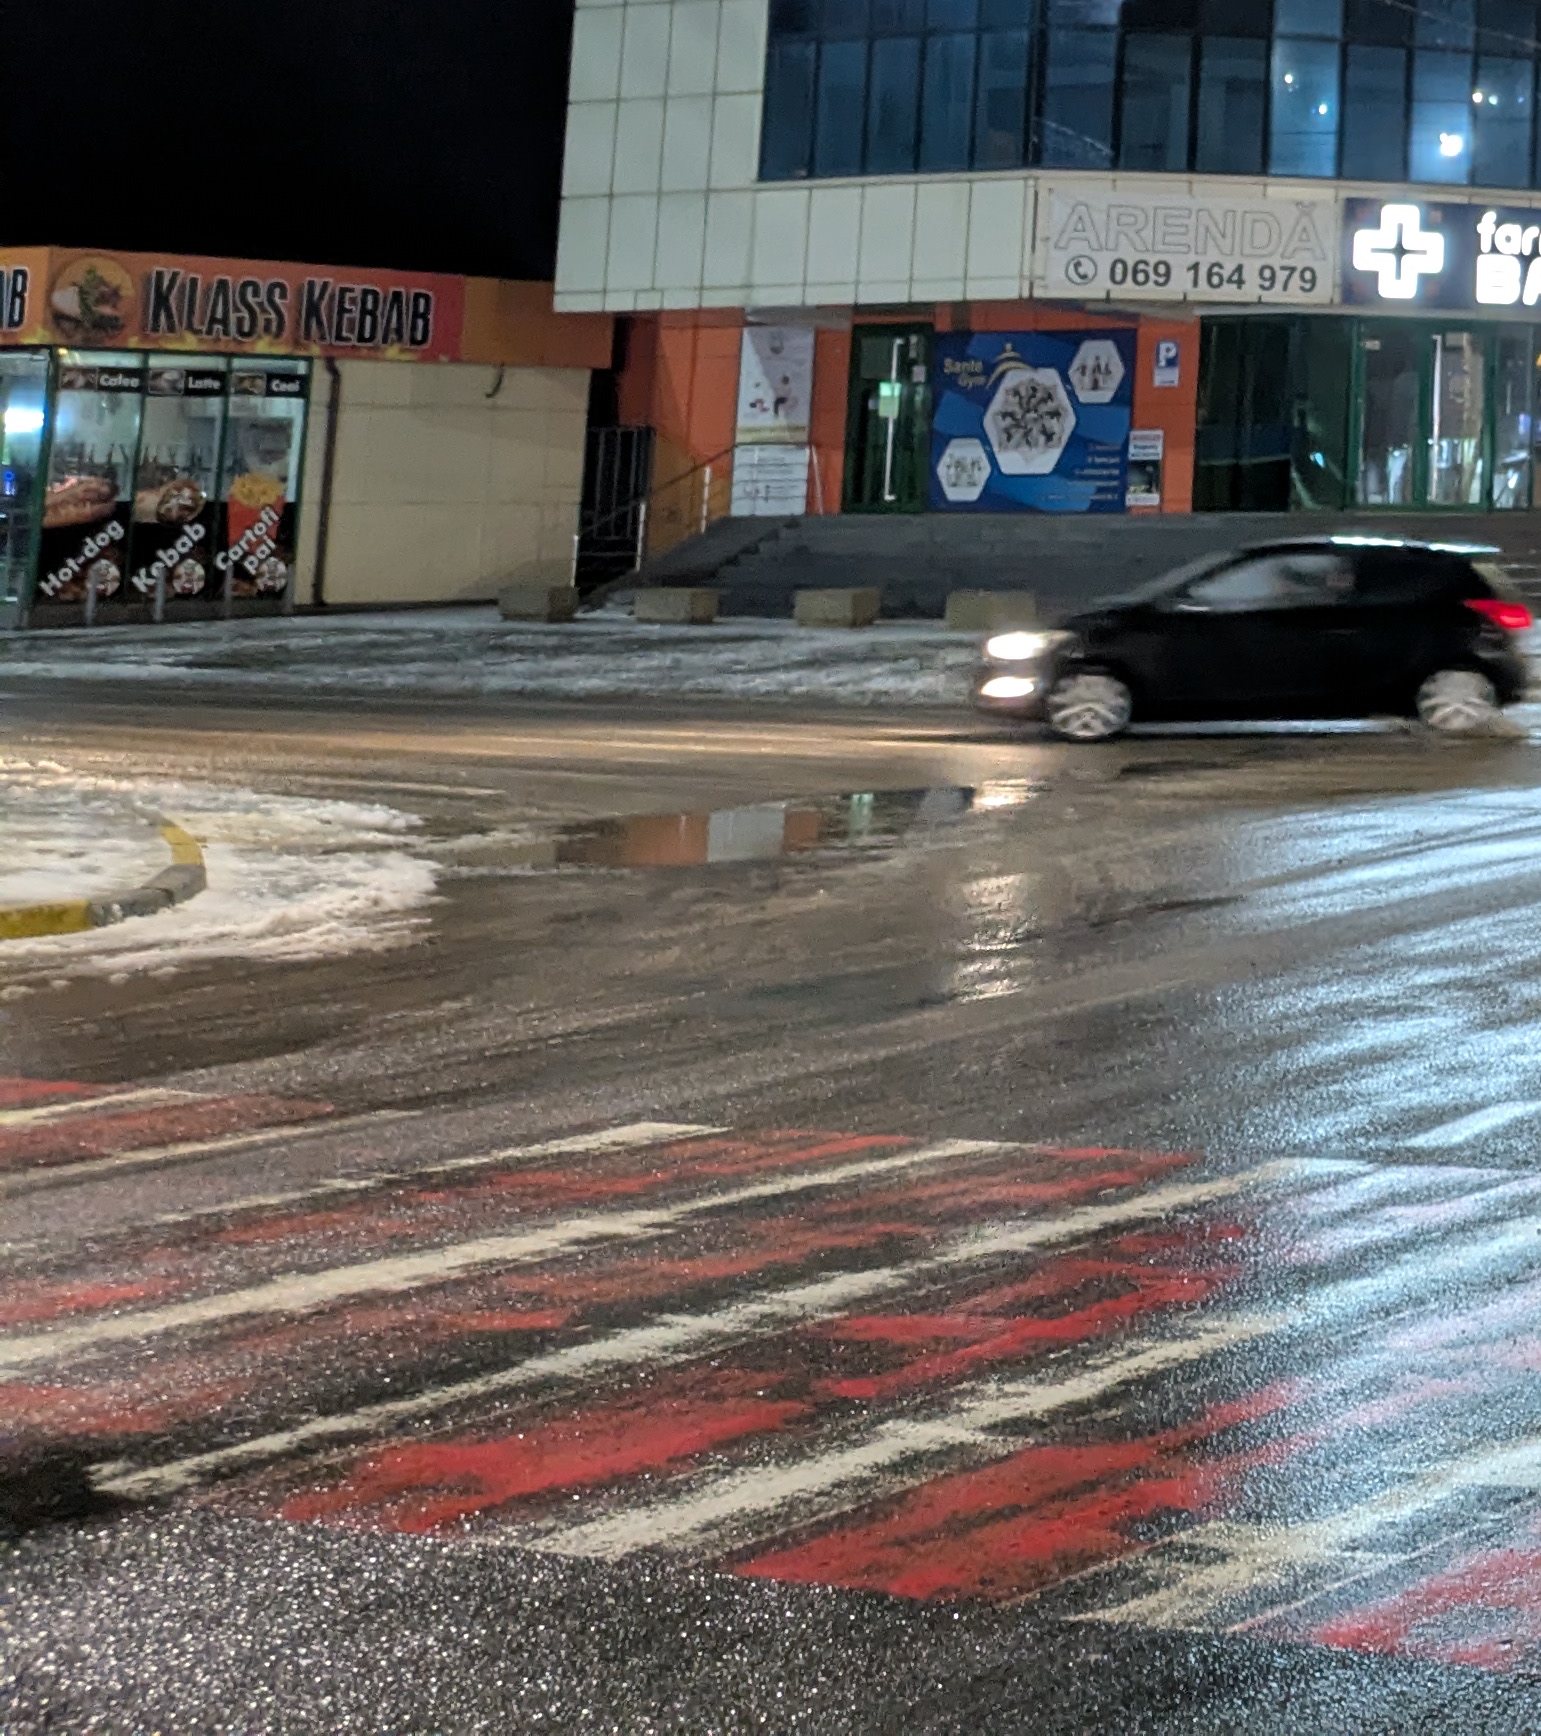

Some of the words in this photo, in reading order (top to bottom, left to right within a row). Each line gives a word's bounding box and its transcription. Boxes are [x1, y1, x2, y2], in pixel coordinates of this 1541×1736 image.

[1054, 202, 1327, 261] ARENDĂ
[1109, 258, 1172, 287] 069
[1186, 261, 1246, 290] 164
[1258, 265, 1317, 293] 979
[148, 268, 289, 340] KLASS
[302, 279, 433, 347] KEBAB
[1158, 341, 1178, 367] P
[39, 520, 125, 596] Hot-dog
[132, 522, 207, 593] Kebab
[215, 506, 280, 571] Cartofi
[242, 535, 279, 575] pai
